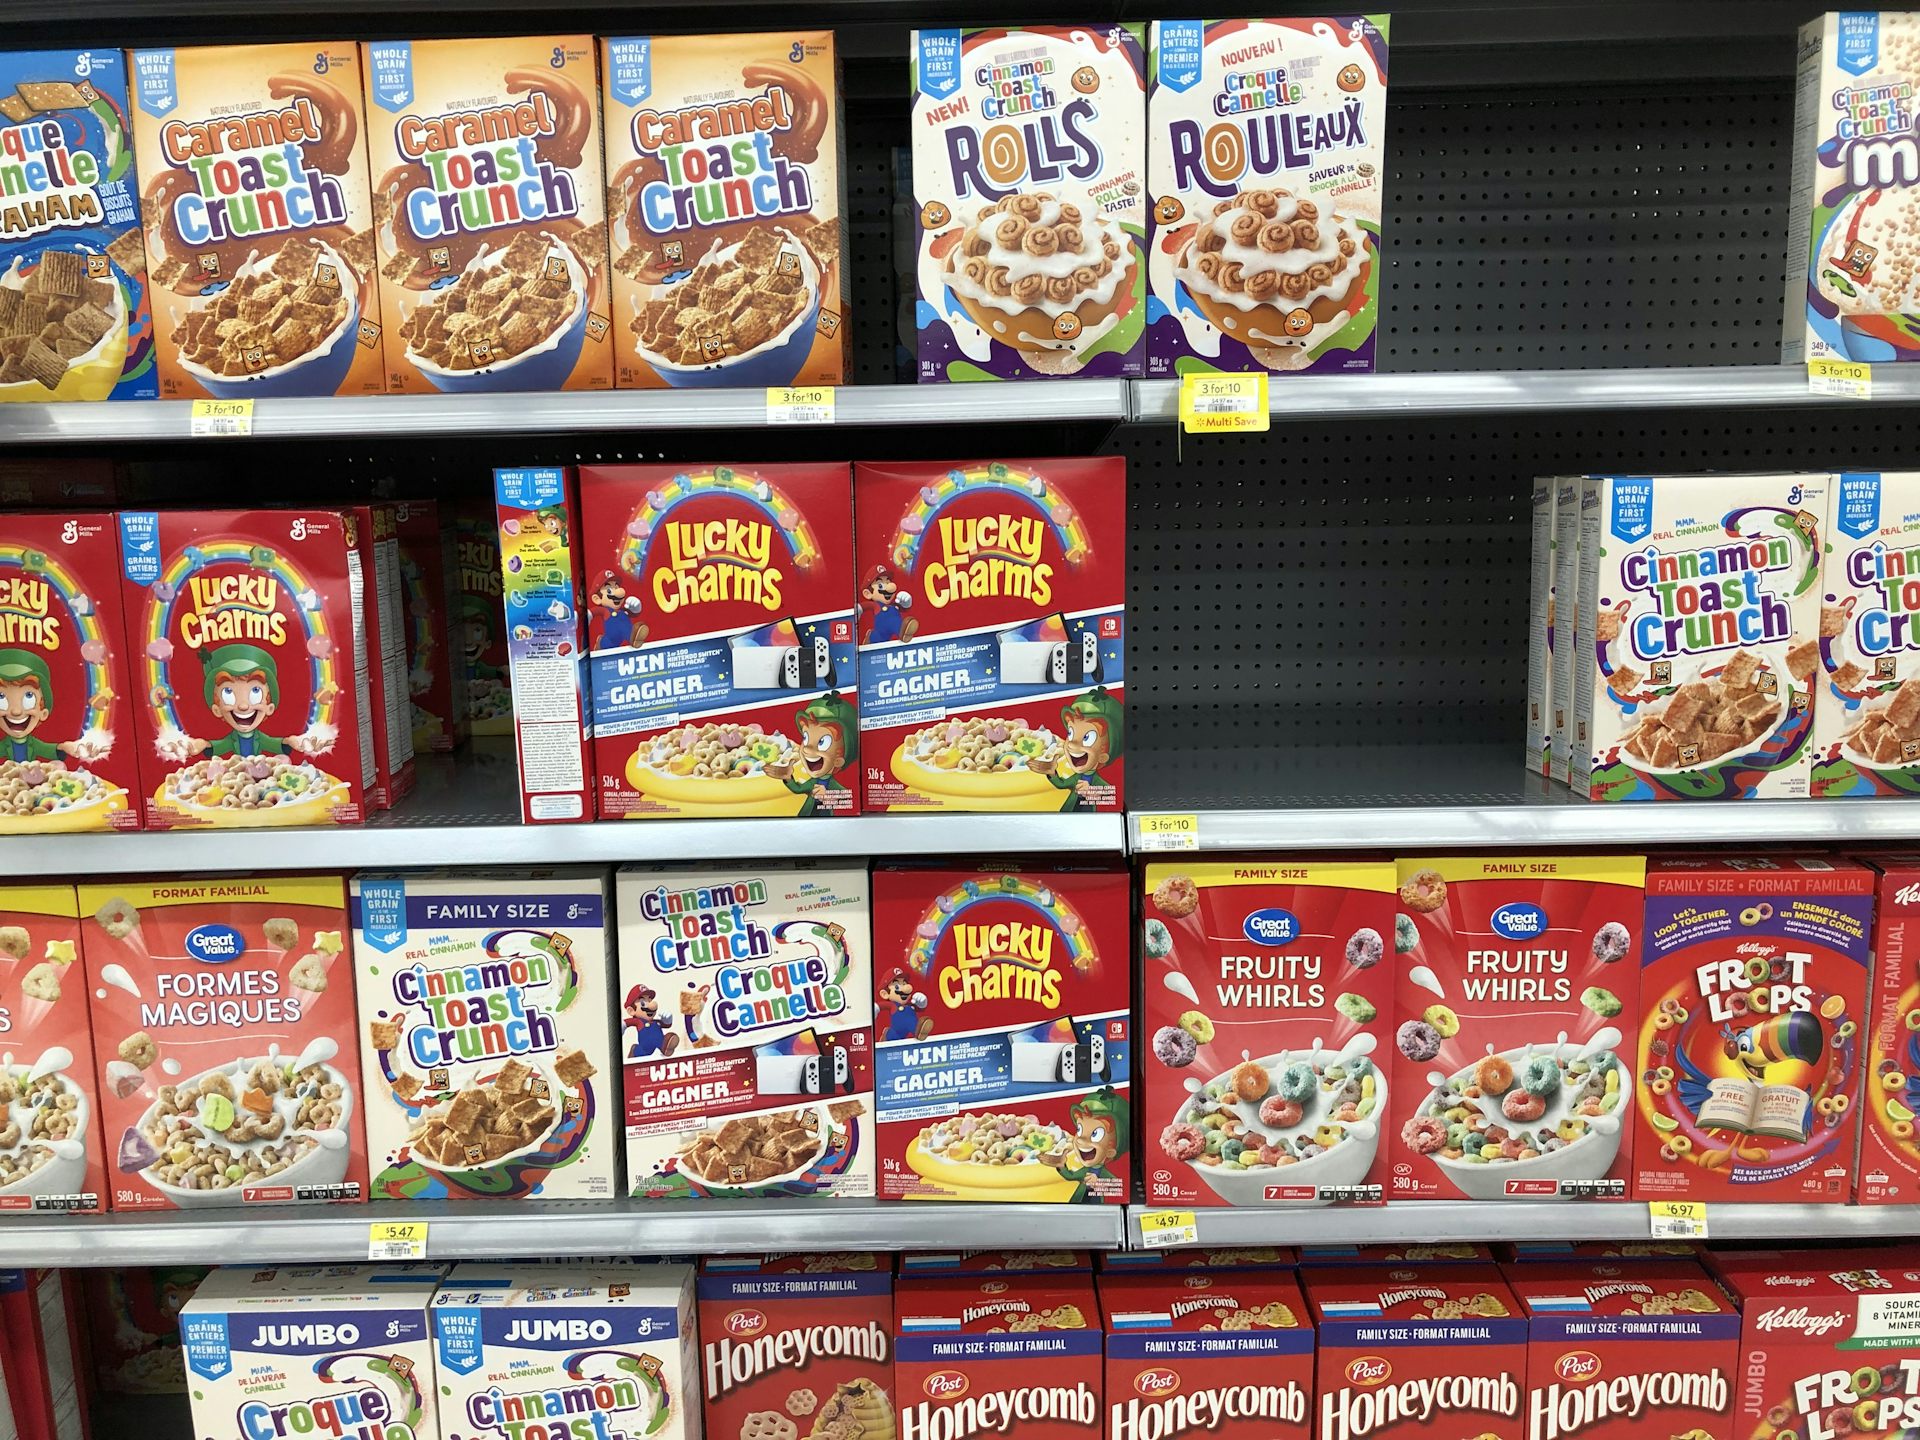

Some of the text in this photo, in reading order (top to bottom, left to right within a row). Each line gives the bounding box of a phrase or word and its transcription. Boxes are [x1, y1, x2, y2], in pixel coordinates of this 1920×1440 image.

[921, 37, 957, 48] WHOLE
[1163, 28, 1199, 39] GRAINS
[1163, 37, 1200, 48] ENTIERS
[136, 55, 172, 66] WHOLE
[925, 46, 955, 57] GRAIN
[1163, 52, 1200, 64] PREMIER
[1220, 42, 1274, 69] NOUVEAU
[141, 64, 170, 76] GRAIN
[926, 61, 953, 71] FIRST
[979, 57, 1053, 85] Cinnamon
[143, 79, 169, 90] FIRST
[992, 74, 1041, 99] Toast
[1225, 67, 1286, 94] Croque
[984, 86, 1057, 120] Crunch
[1214, 79, 1303, 117] Cannelle
[1834, 84, 1911, 107] Cinnamon
[210, 101, 262, 116] NATURALLY FLAVOURED
[636, 89, 789, 152] Caramel
[926, 96, 970, 127] NEW!
[1850, 99, 1897, 120] Toast
[164, 100, 319, 160] Caramel
[401, 94, 553, 154] Caramel
[1838, 109, 1910, 139] Crunch
[944, 97, 1100, 197] ROLLS
[1169, 96, 1366, 195] ROULEAUX
[424, 138, 539, 192] Toast
[661, 132, 775, 186] Toast
[191, 145, 305, 198] Toast
[1308, 166, 1345, 184] SAVEUR
[640, 158, 812, 232] Crunch
[1087, 171, 1136, 197] CINNAMON
[1329, 179, 1371, 198] CANNELLE
[103, 193, 133, 211] BISCUITS
[176, 172, 344, 243] Crunch
[408, 163, 577, 236] Crunch
[1095, 189, 1123, 207] ROLL
[1103, 197, 1136, 214] TASTE!
[107, 207, 136, 225] GRAHAM
[1811, 341, 1830, 351] 349 g
[783, 392, 822, 402] 3 for $10
[1202, 383, 1241, 393] 3 for $10
[1206, 416, 1258, 427] Multi Save
[938, 514, 1044, 566] Lucky
[1653, 523, 1720, 541] REAL CINNAMON
[664, 518, 772, 571] Lucky
[1627, 539, 1789, 586] Cinnamon
[189, 573, 278, 616] Lucky
[652, 562, 783, 614] Charms
[924, 558, 1053, 609] Charms
[1656, 570, 1759, 618] Toast
[180, 610, 287, 650] Charms
[1635, 594, 1789, 656] Crunch
[617, 652, 665, 676] WIN
[886, 647, 934, 670] WIN
[610, 674, 703, 704] GAGNER
[878, 668, 971, 698] GAGNER
[602, 775, 621, 790] 526 g
[1234, 869, 1308, 879] FAMILY SIZE
[1483, 863, 1557, 873] FAMILY SIZE
[152, 885, 270, 899] FORMAT FAMILIAL
[643, 880, 766, 916] Cinnamon
[1658, 879, 1865, 893] FAMILY SIZE FORMAT FAMILIAL
[426, 904, 550, 920] FAMILY SIZE
[667, 905, 744, 940] Toast
[1250, 917, 1290, 930] Great
[1498, 911, 1538, 924] Great
[1654, 909, 1729, 938] LOOP TOGETHER.
[1673, 908, 1697, 921] Let's
[1792, 901, 1861, 927] ENSEMBLE dans
[1260, 928, 1291, 938] Value
[1507, 922, 1538, 933] Value
[1794, 911, 1829, 925] MONDE
[1828, 919, 1864, 939] COLORÉ.
[192, 933, 235, 948] Great
[203, 943, 236, 956] Value
[655, 925, 769, 969] Crunch
[953, 922, 1053, 970] Lucky
[1736, 943, 1777, 956] Kellogg's
[1220, 956, 1322, 980] FRUITY
[1467, 950, 1569, 974] FRUITY
[156, 970, 280, 998] FORMES
[399, 957, 548, 1001] Cinnamon
[719, 957, 824, 1000] Croque
[1697, 952, 1812, 997] FROOT
[1879, 922, 1906, 1050] FORMAT FAMILIAL
[938, 964, 1063, 1010] Charms
[1216, 984, 1326, 1008] WHIRLS
[1462, 978, 1572, 1002] WHIRLS
[140, 998, 301, 1029] MAGIQUES
[428, 986, 524, 1029] Toast
[717, 985, 842, 1031] Cannelle
[1709, 984, 1814, 1023] LOOPS
[412, 1008, 555, 1064] Crunch
[902, 1046, 948, 1066] WIN
[649, 1061, 694, 1082] WIN
[894, 1067, 983, 1092] GAGNER
[642, 1081, 730, 1108] GAGNER
[1720, 1091, 1745, 1102] FREE
[1761, 1094, 1801, 1105] GRATUIT
[1153, 1183, 1170, 1196] 580
[1171, 1185, 1178, 1197] g
[1802, 1180, 1816, 1189] 480
[385, 1226, 414, 1238] $5.47
[1156, 1215, 1180, 1227] $4.97
[732, 1280, 858, 1294] FAMILY SIZE FORMAT FAMILIAL
[1763, 1275, 1816, 1287] Kellogg's
[731, 1312, 761, 1331] Post
[963, 1301, 1031, 1323] Honeycomb
[1756, 1305, 1845, 1335] Kellogg's
[251, 1323, 360, 1347] JUMBO
[504, 1319, 613, 1341] JUMBO
[1863, 1337, 1914, 1347] MADE WITH
[705, 1321, 887, 1400] Honeycomb
[1352, 1361, 1385, 1380] Post
[930, 1374, 962, 1394] Post
[1141, 1372, 1174, 1391] Post
[1744, 1351, 1767, 1418] JUMBO
[243, 1390, 384, 1440] Croque
[472, 1380, 636, 1426] Cinnamon
[902, 1382, 1096, 1440] Honeycomb
[1111, 1380, 1305, 1440] Honeycomb
[1322, 1372, 1518, 1440] Honeycomb
[1529, 1368, 1727, 1440] Honeycomb
